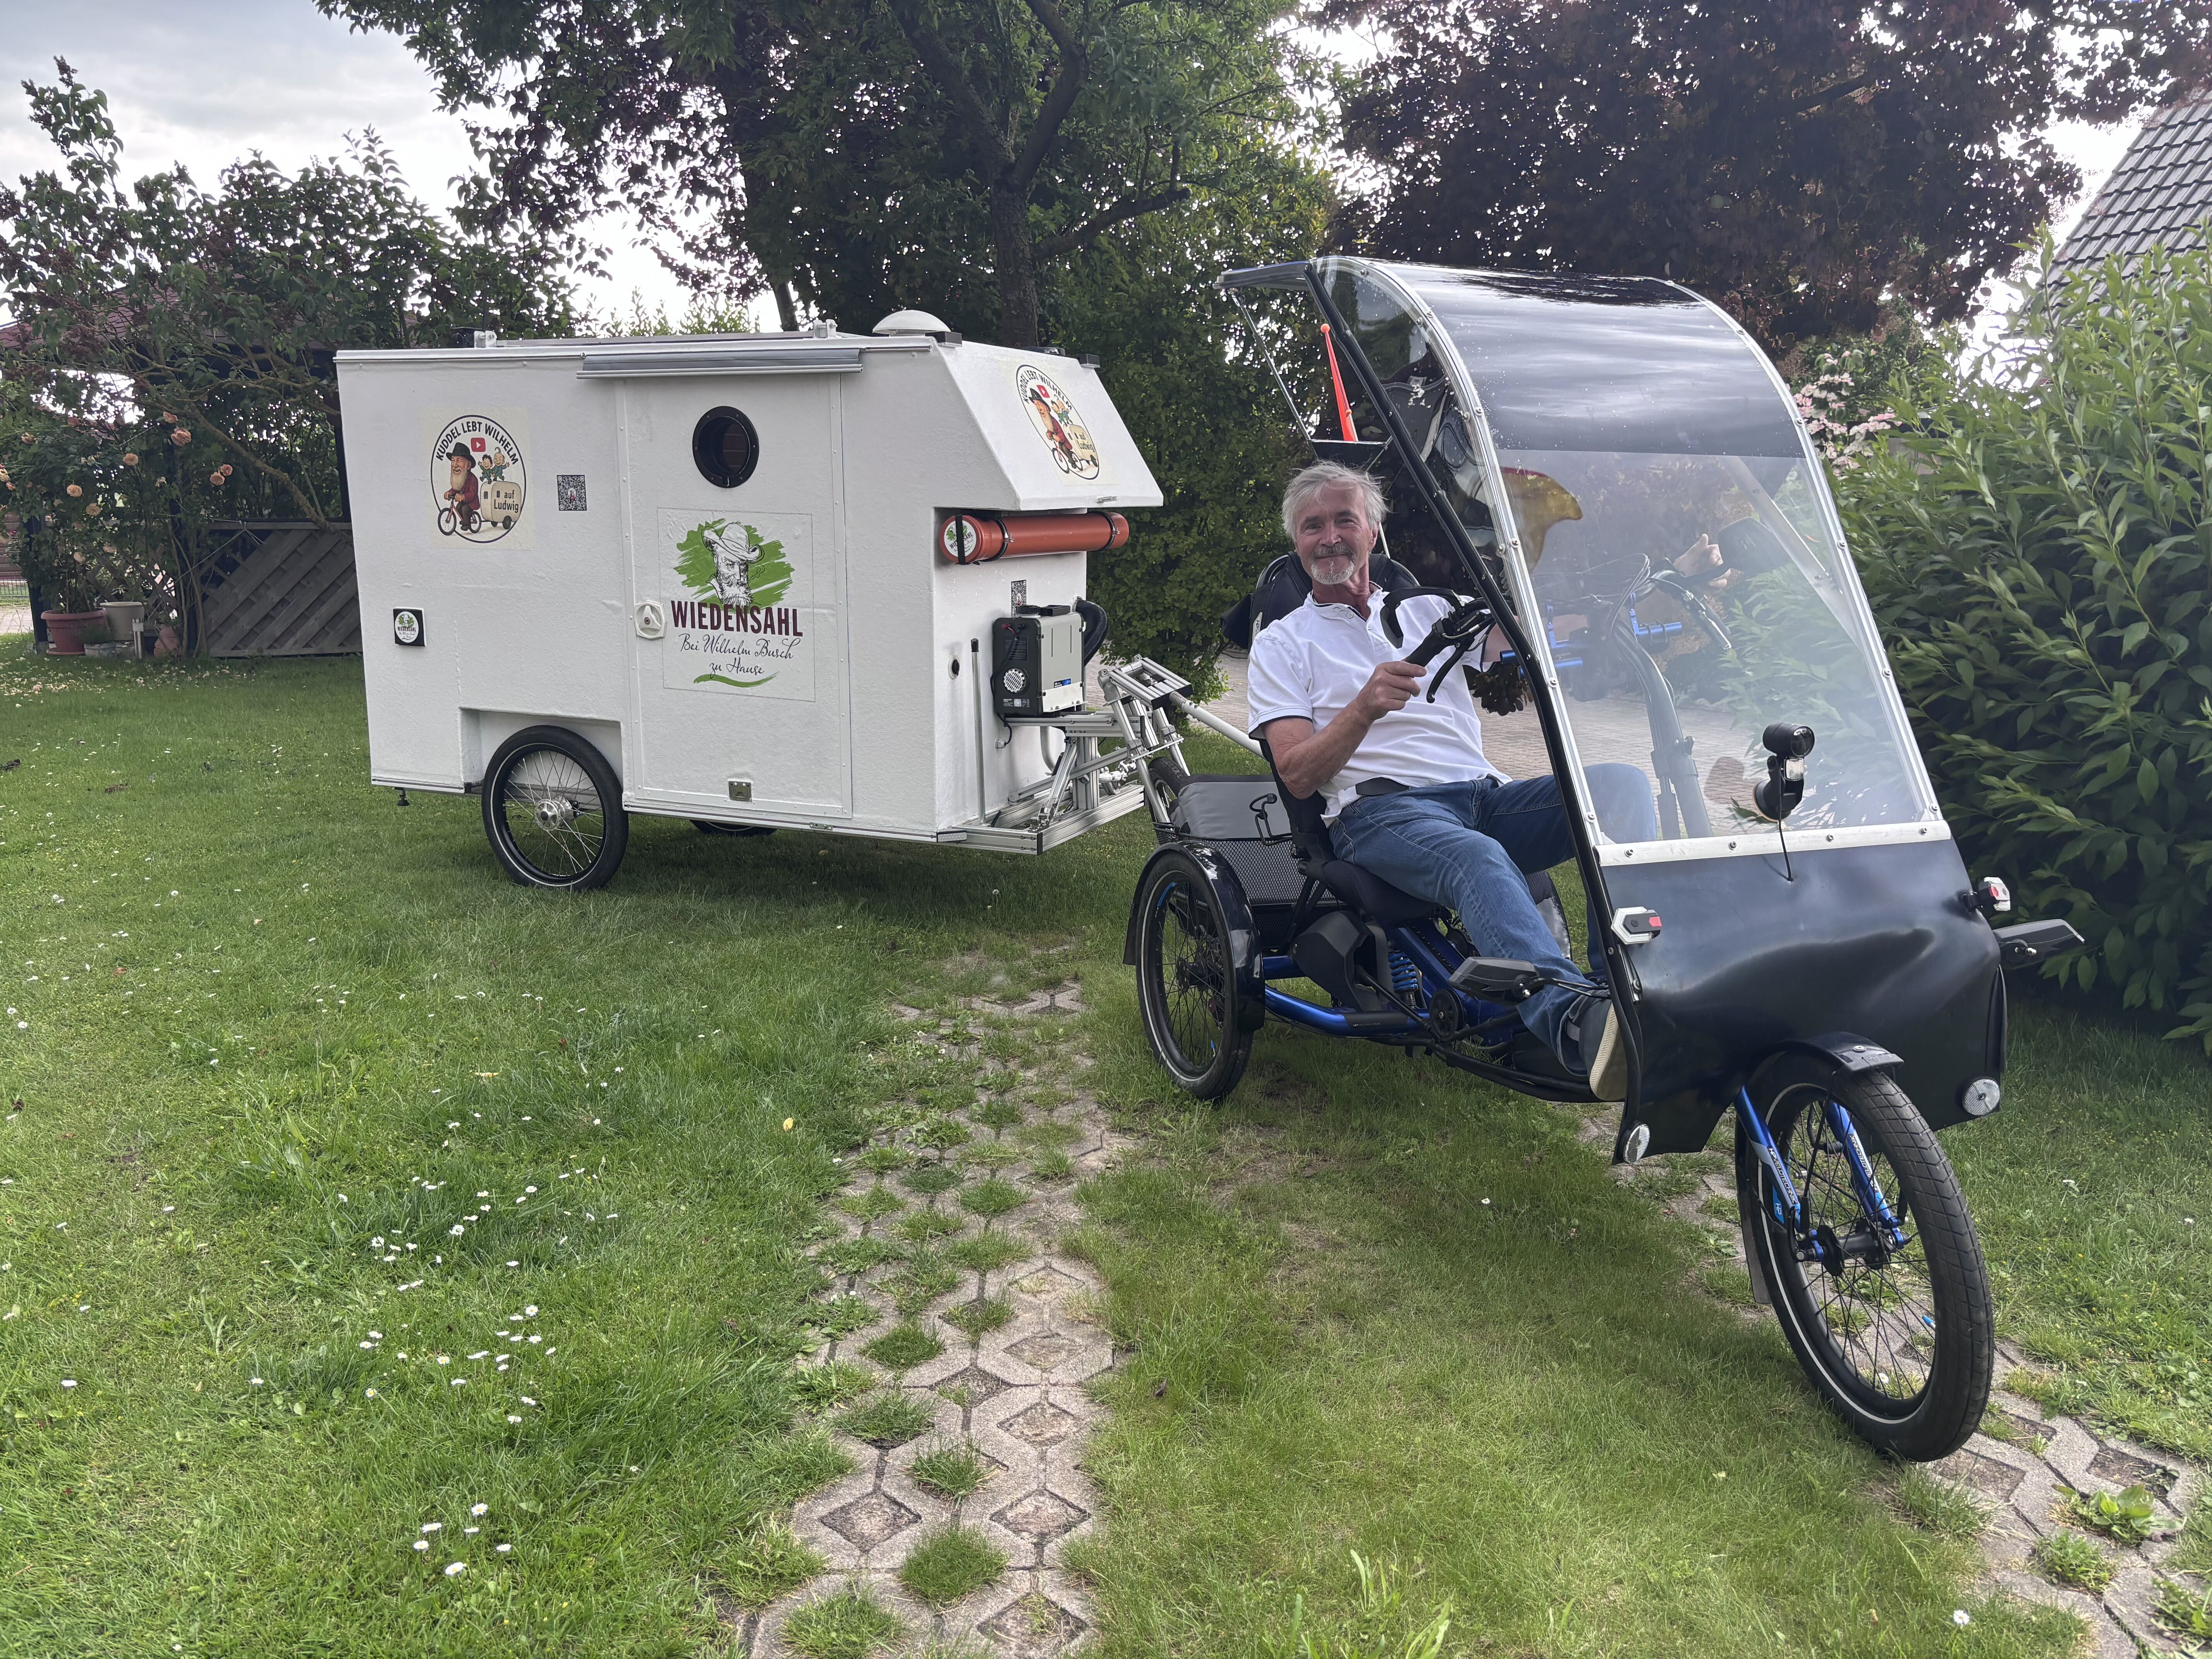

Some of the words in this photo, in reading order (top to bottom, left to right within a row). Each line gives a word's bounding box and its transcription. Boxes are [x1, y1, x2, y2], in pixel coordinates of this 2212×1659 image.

[1024, 370, 1039, 381] LEBT
[1020, 373, 1030, 404] KUDDEL
[1038, 373, 1072, 410] WILHELM
[436, 426, 461, 461] KUDDEL
[461, 421, 482, 434] LEBT
[485, 423, 519, 465] WILHELM
[504, 489, 515, 499] auf
[494, 499, 519, 513] Ludwig
[949, 532, 973, 549] WIESAHL
[671, 600, 803, 637] WIEDENSAHL
[678, 633, 699, 652] Bei
[702, 634, 751, 655] Wilhelm
[754, 638, 801, 659] Busch
[709, 662, 722, 679] zu
[726, 657, 765, 675] Hause
[1775, 1202, 1782, 1216] HP
